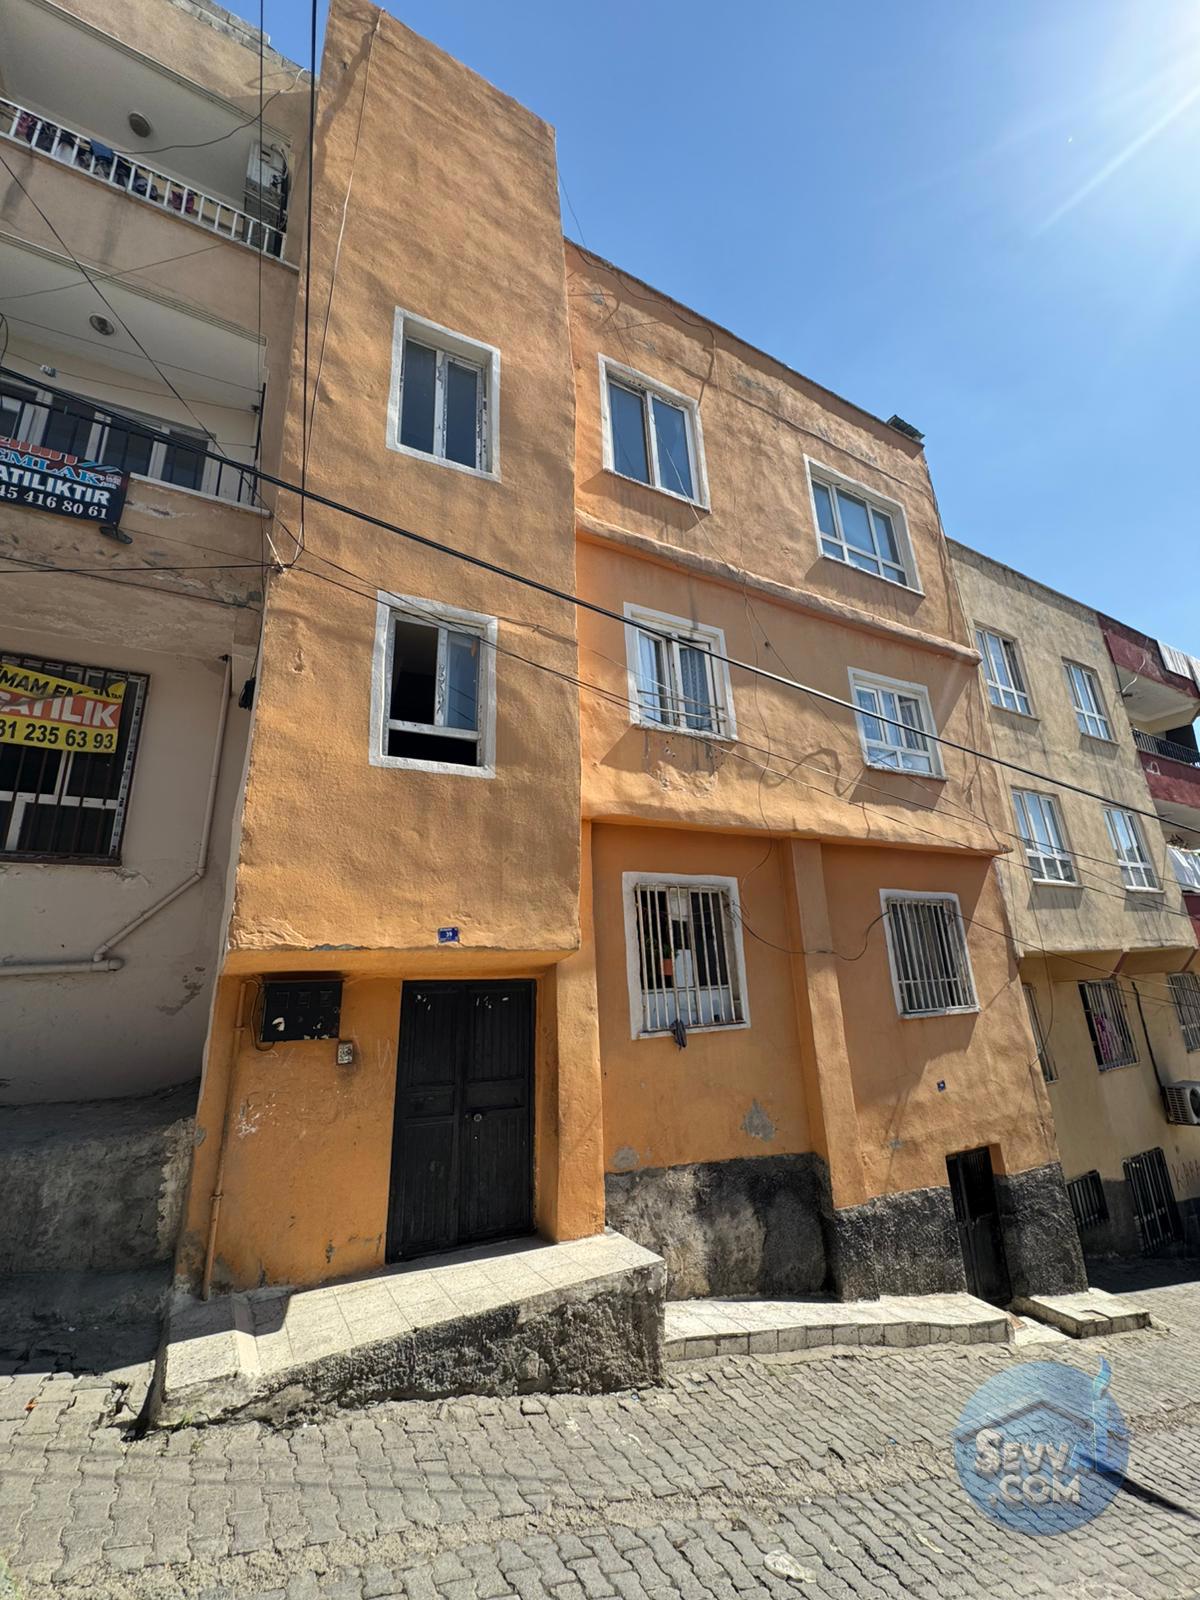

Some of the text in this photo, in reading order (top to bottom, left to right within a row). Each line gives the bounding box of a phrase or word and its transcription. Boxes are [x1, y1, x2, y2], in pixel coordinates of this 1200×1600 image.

[24, 490, 57, 508] 416
[62, 500, 84, 515] 80
[88, 505, 107, 519] 61
[24, 723, 60, 745] 235
[65, 729, 88, 748] 63
[93, 733, 114, 750] 93
